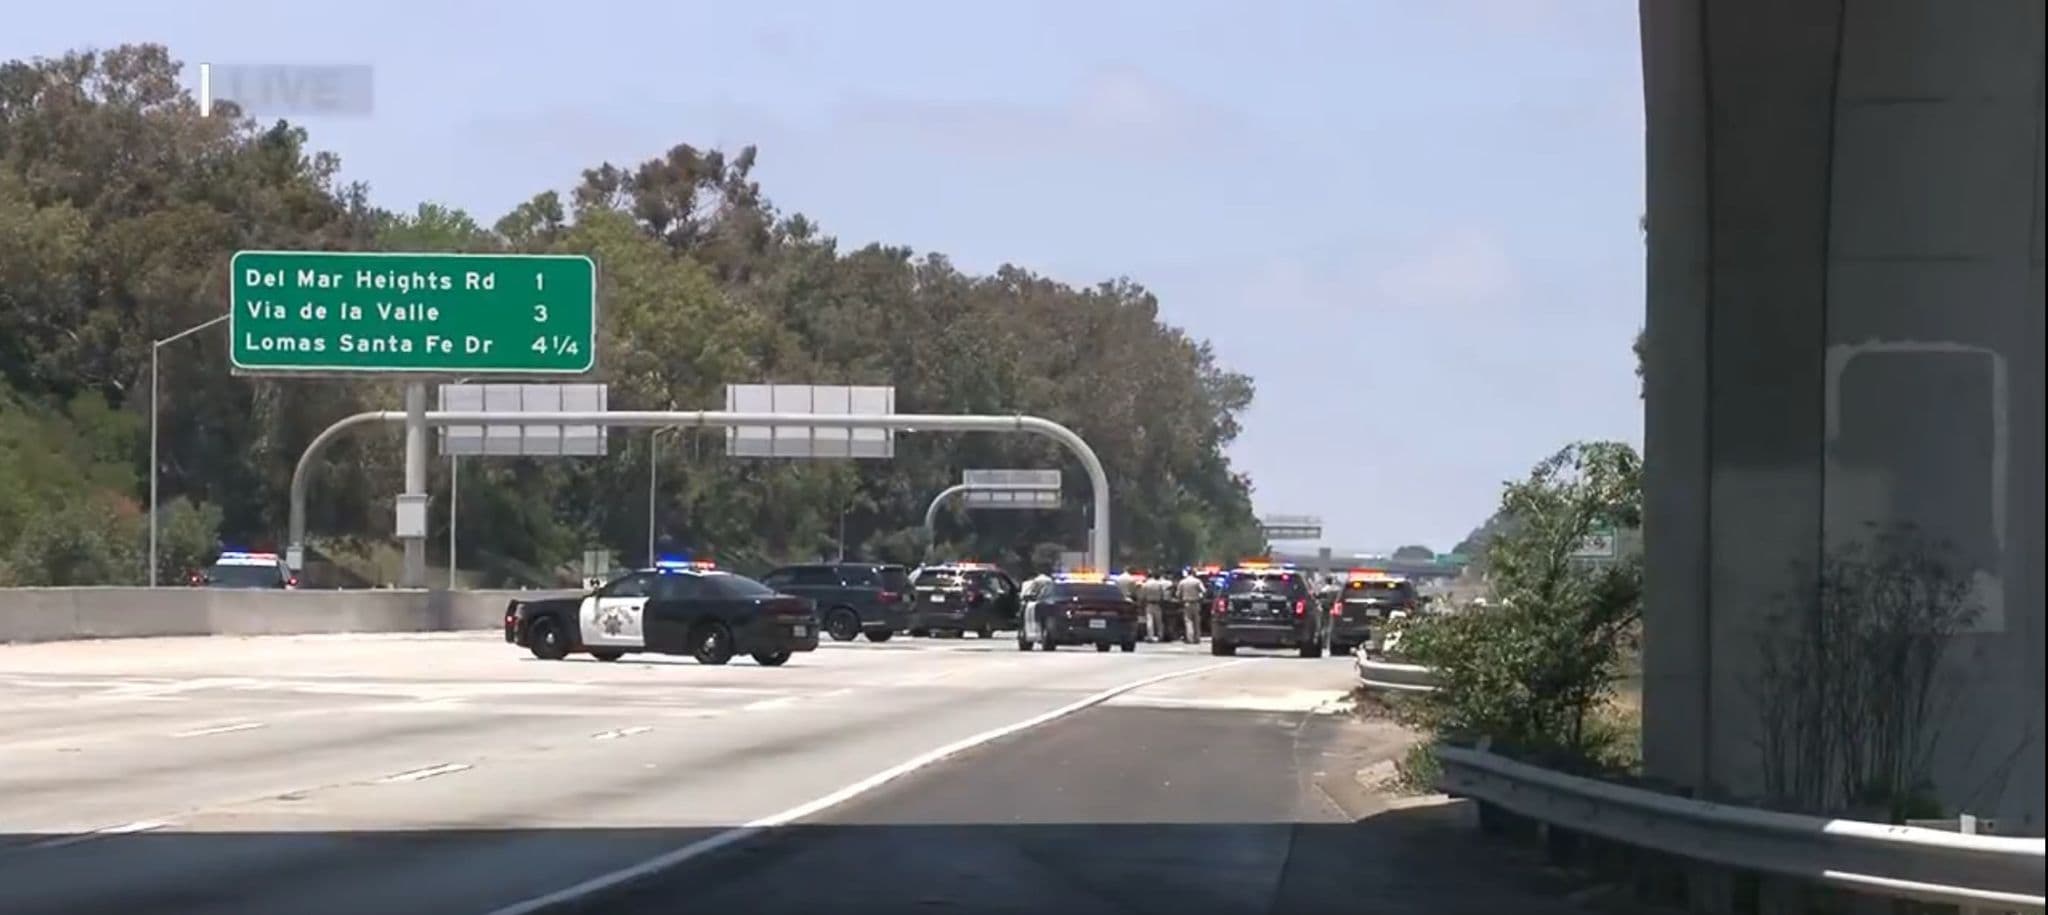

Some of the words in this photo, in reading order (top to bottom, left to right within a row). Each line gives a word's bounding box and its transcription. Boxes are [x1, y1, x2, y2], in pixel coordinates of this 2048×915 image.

[246, 269, 284, 287] Del
[297, 269, 343, 288] Mar
[356, 270, 452, 294] Heights
[465, 271, 495, 290] Rd
[535, 272, 543, 290] 1
[247, 301, 286, 319] Via
[299, 302, 327, 320] de
[341, 303, 362, 320] la
[377, 303, 439, 321] Valle
[534, 304, 548, 322] 3
[246, 332, 326, 352] Lomas
[340, 334, 413, 353] Santa
[426, 335, 453, 353] Fe
[465, 335, 493, 353] Dr
